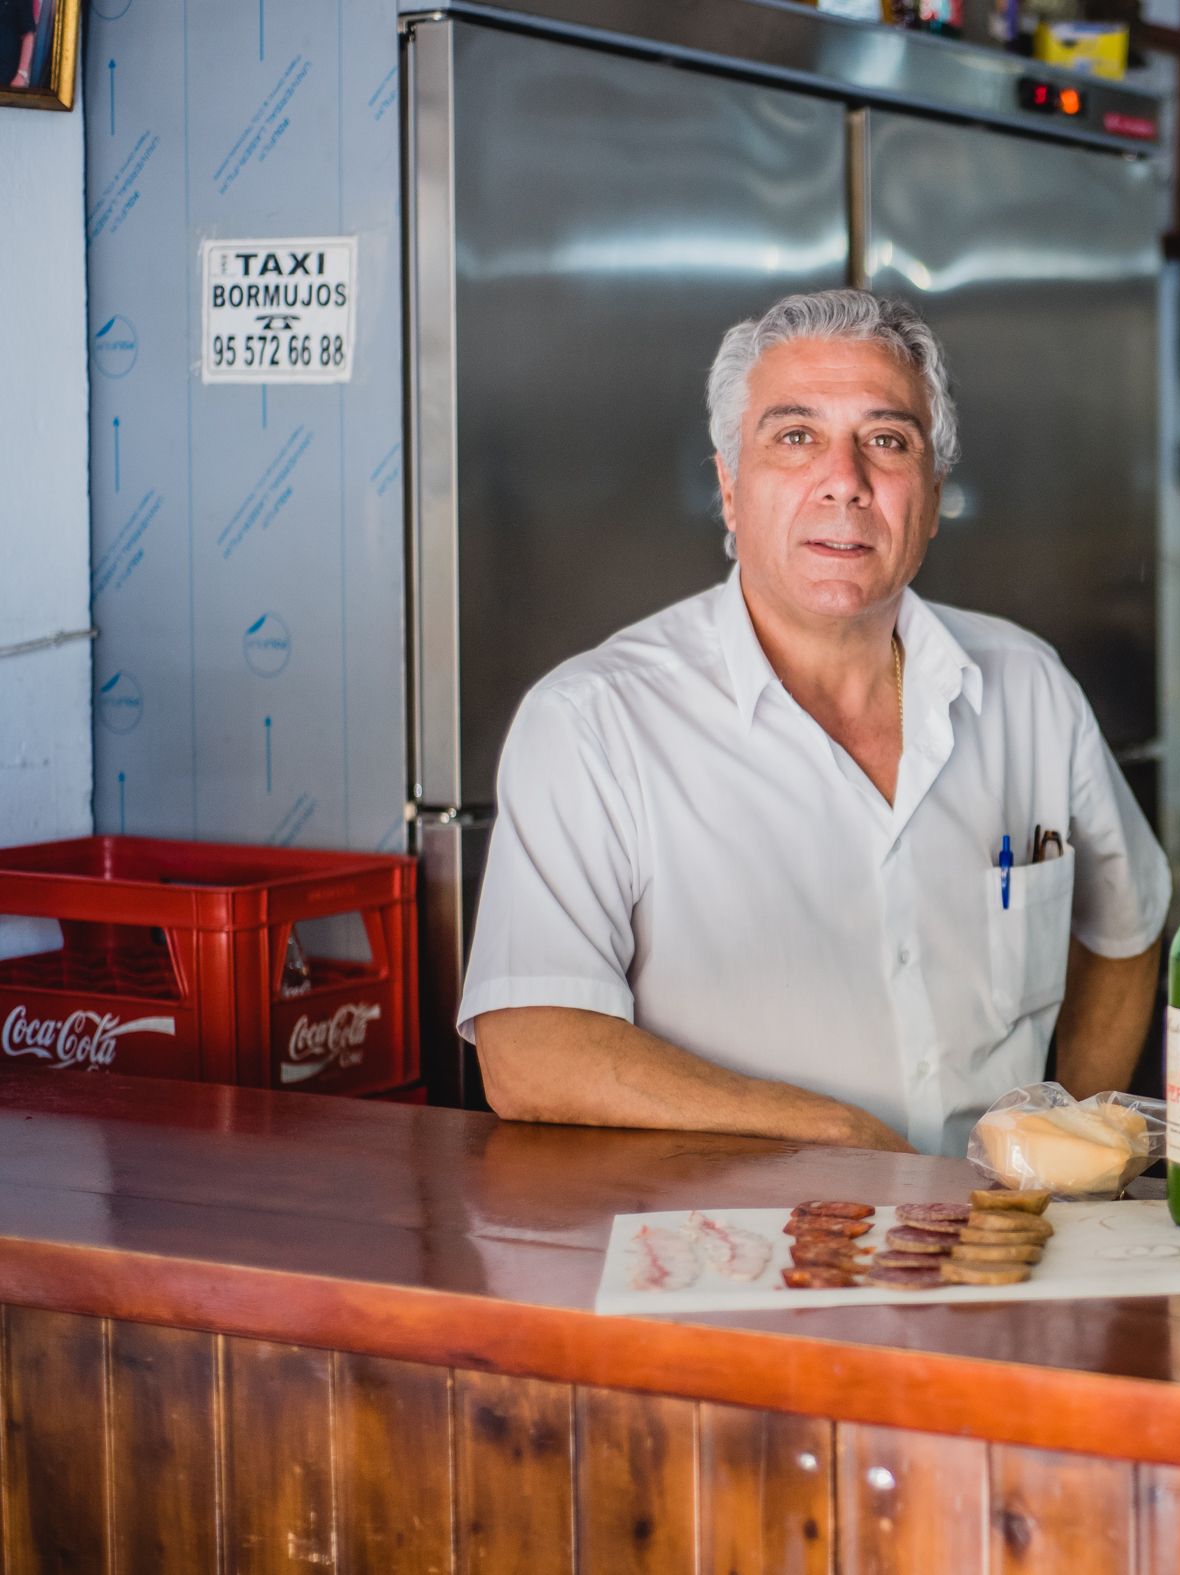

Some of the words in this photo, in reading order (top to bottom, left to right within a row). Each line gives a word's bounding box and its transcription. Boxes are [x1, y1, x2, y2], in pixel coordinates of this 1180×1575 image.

[235, 252, 325, 276] TAXI
[212, 283, 347, 308] BORMUJOS
[213, 335, 236, 366] 95
[244, 335, 280, 366] 572
[288, 335, 312, 366] 66
[319, 335, 344, 366] 88
